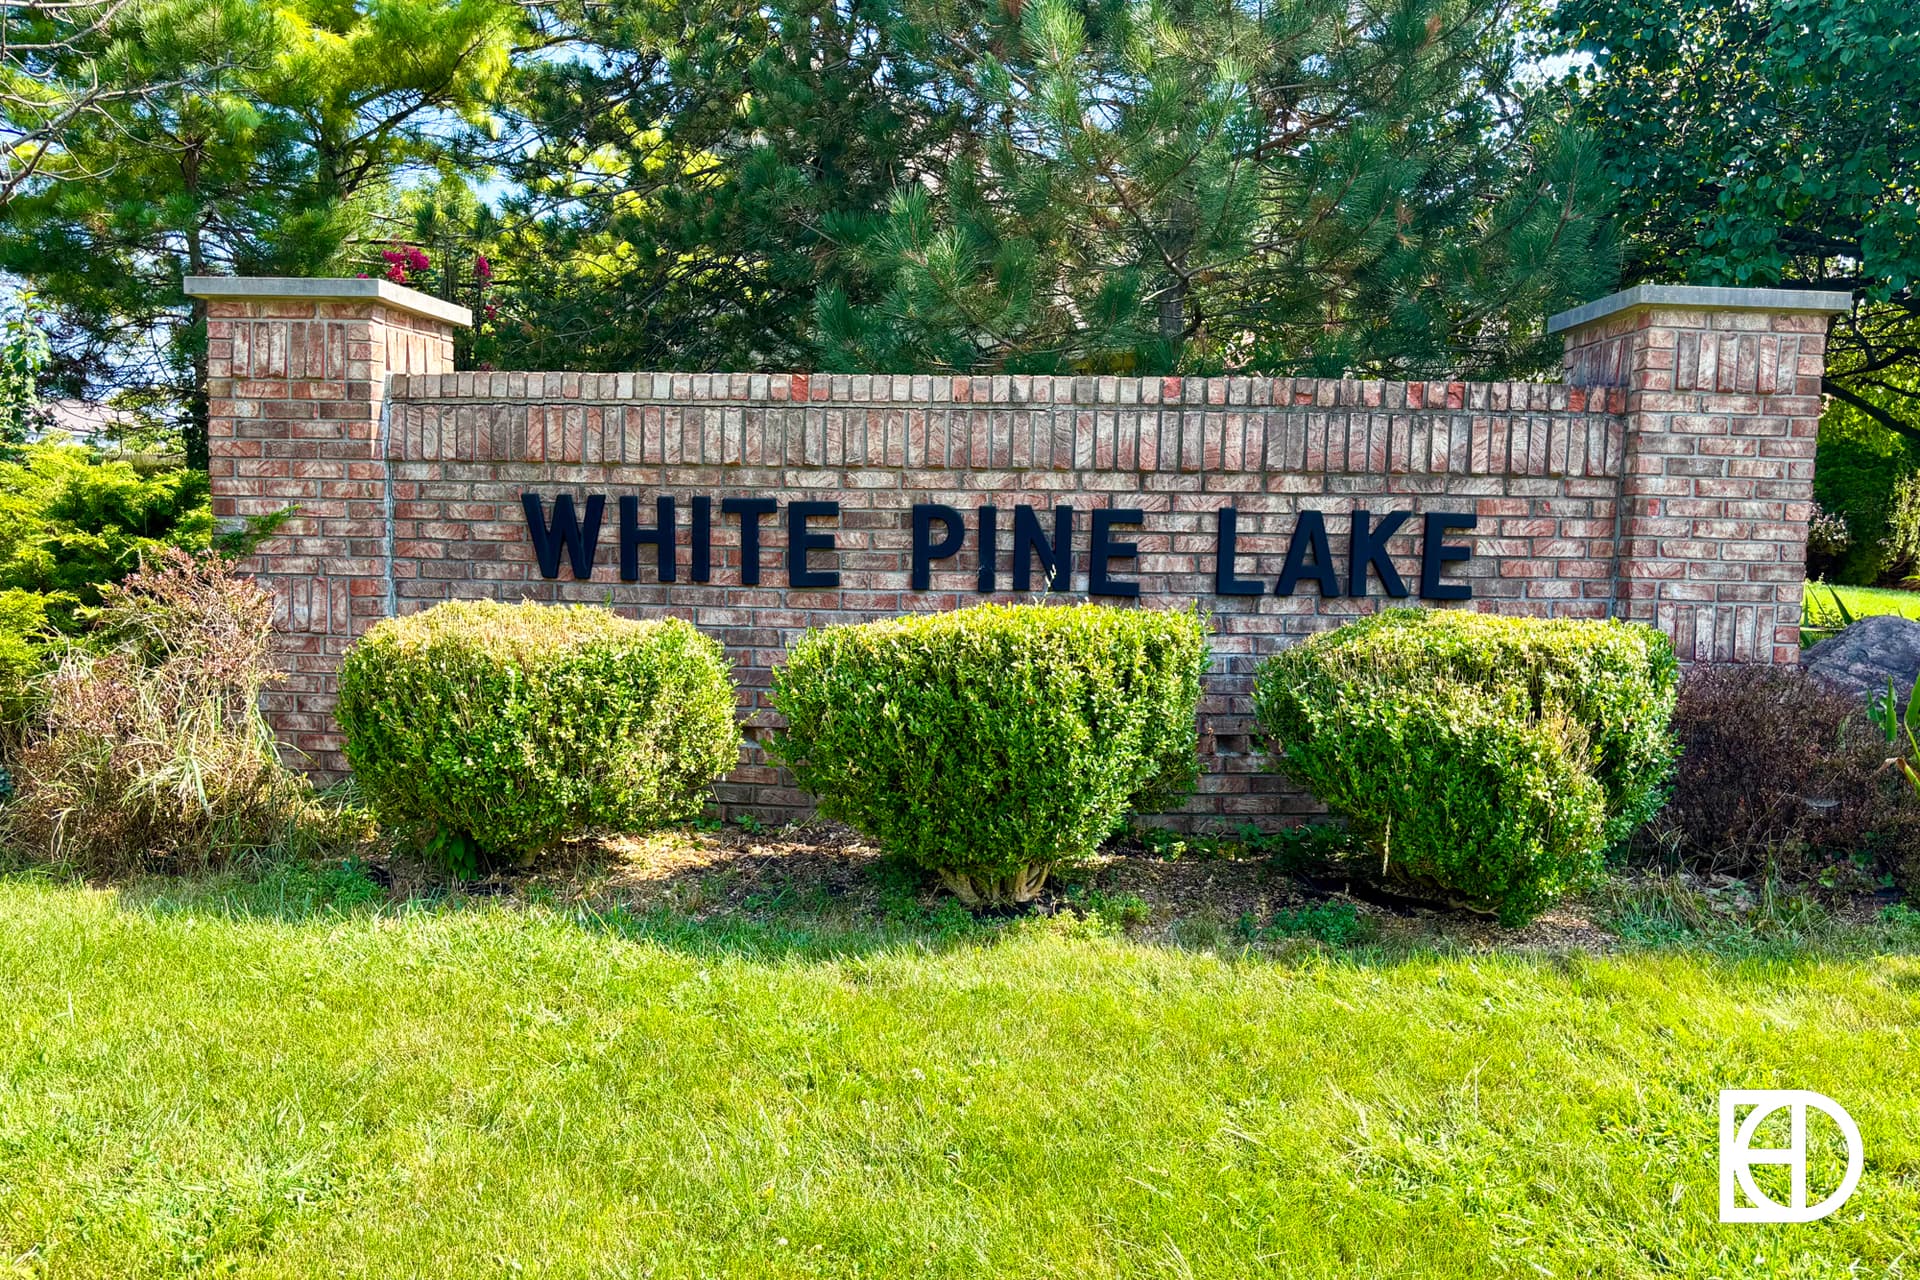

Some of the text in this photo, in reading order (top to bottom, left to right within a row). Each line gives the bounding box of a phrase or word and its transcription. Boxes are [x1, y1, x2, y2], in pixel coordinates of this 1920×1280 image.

[521, 493, 1477, 600] WHITE PINE LAKE
